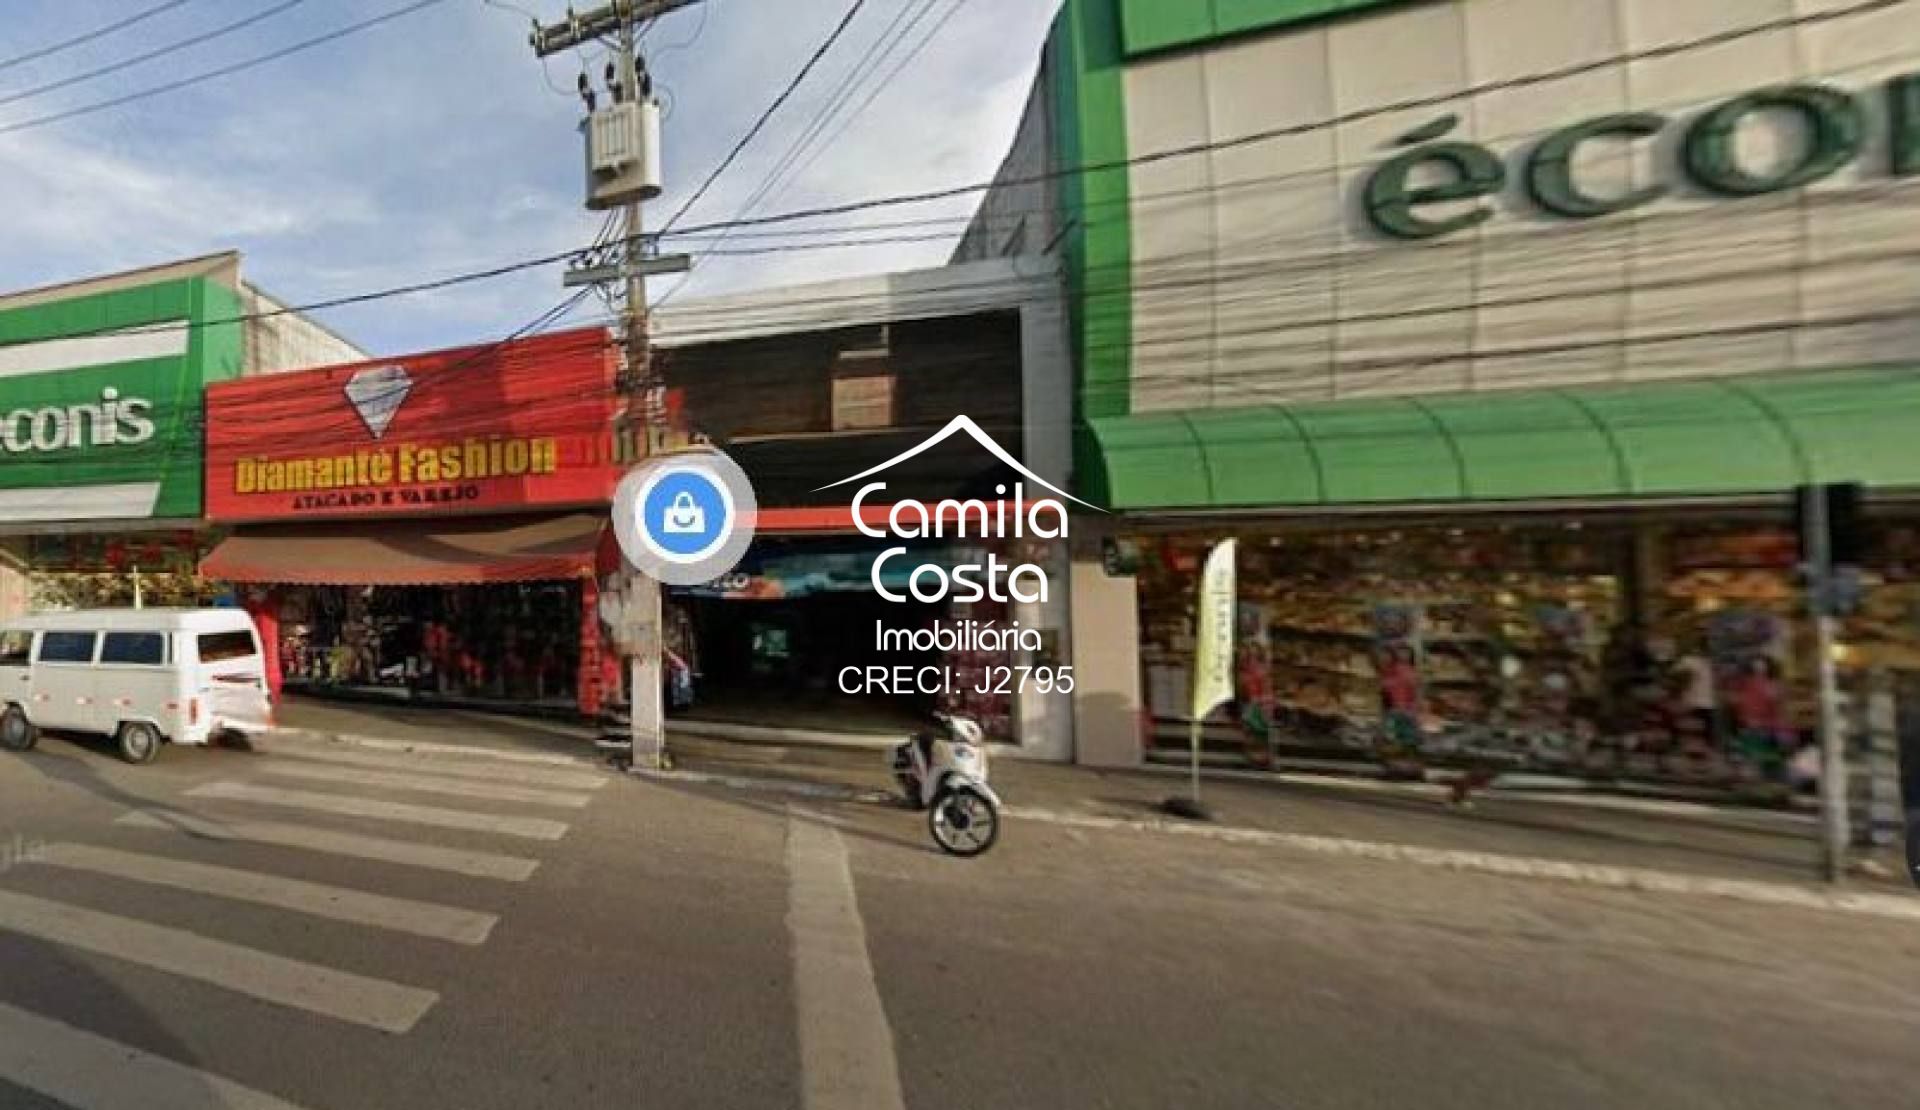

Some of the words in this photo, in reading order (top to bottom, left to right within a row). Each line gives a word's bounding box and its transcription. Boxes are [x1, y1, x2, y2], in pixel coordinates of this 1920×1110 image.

[1364, 75, 1920, 239] éco
[0, 386, 155, 452] conis
[399, 438, 556, 482] Fashion
[292, 494, 376, 510] ATACADO
[381, 491, 393, 505] E
[399, 484, 479, 504] VAREJO
